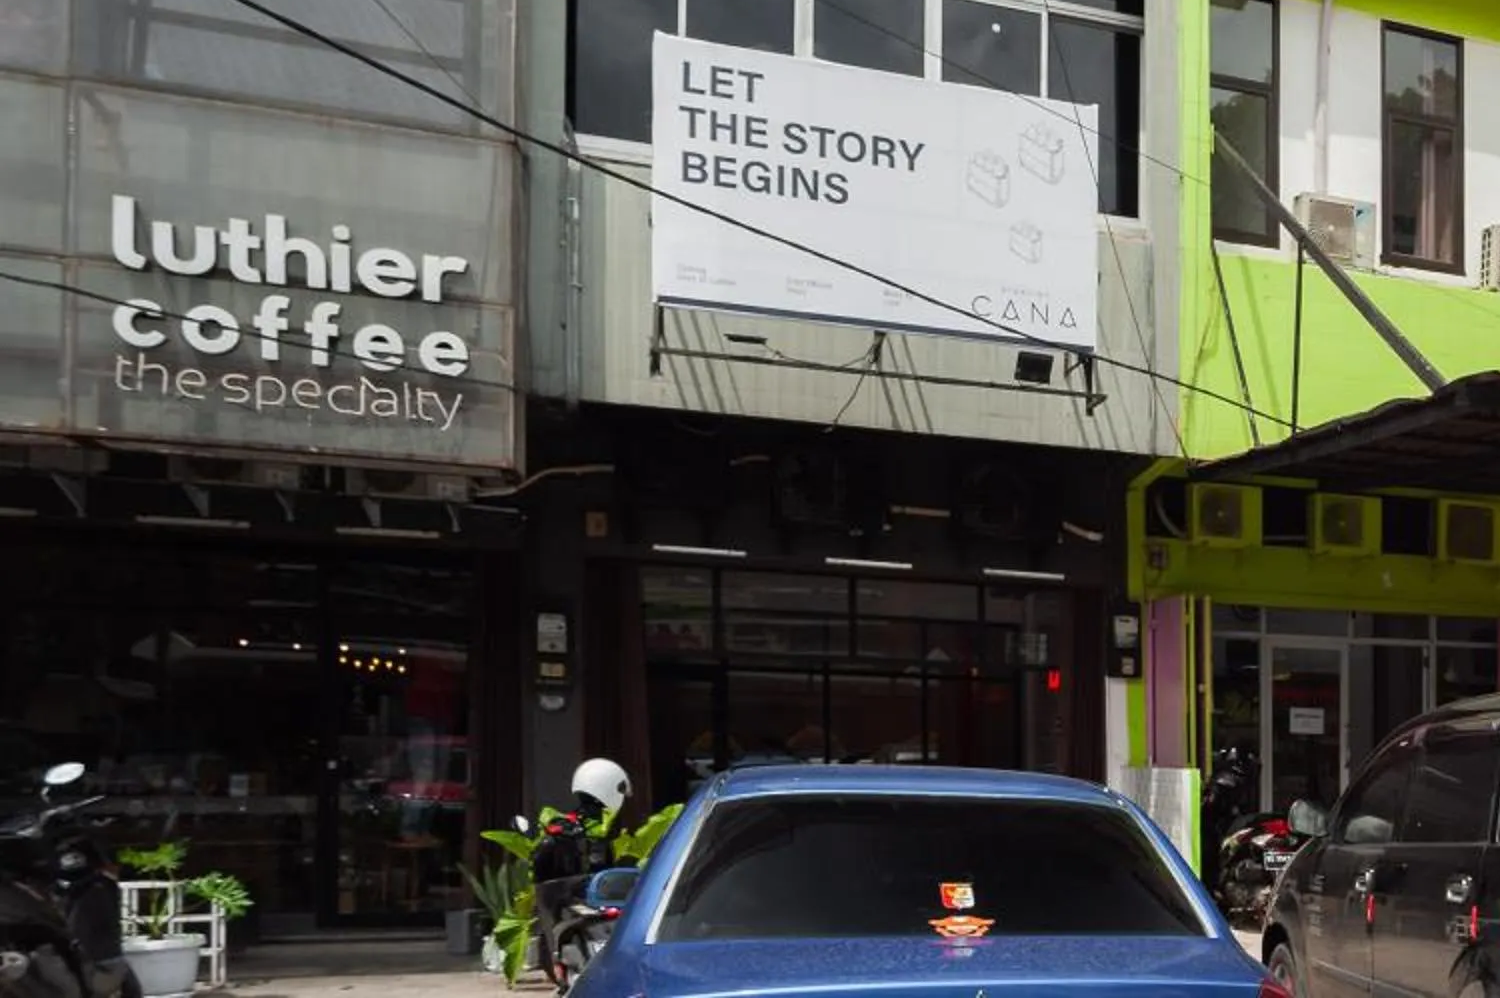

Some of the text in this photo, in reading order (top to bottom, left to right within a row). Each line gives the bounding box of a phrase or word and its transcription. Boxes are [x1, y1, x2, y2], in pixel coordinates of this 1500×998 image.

[682, 61, 763, 103] LET
[679, 106, 925, 172] THE STORY
[681, 153, 849, 204] BEGINS
[112, 195, 468, 305] luthier
[112, 295, 469, 376] coffee
[971, 295, 1077, 328] CANA
[114, 352, 462, 431] the specialty
